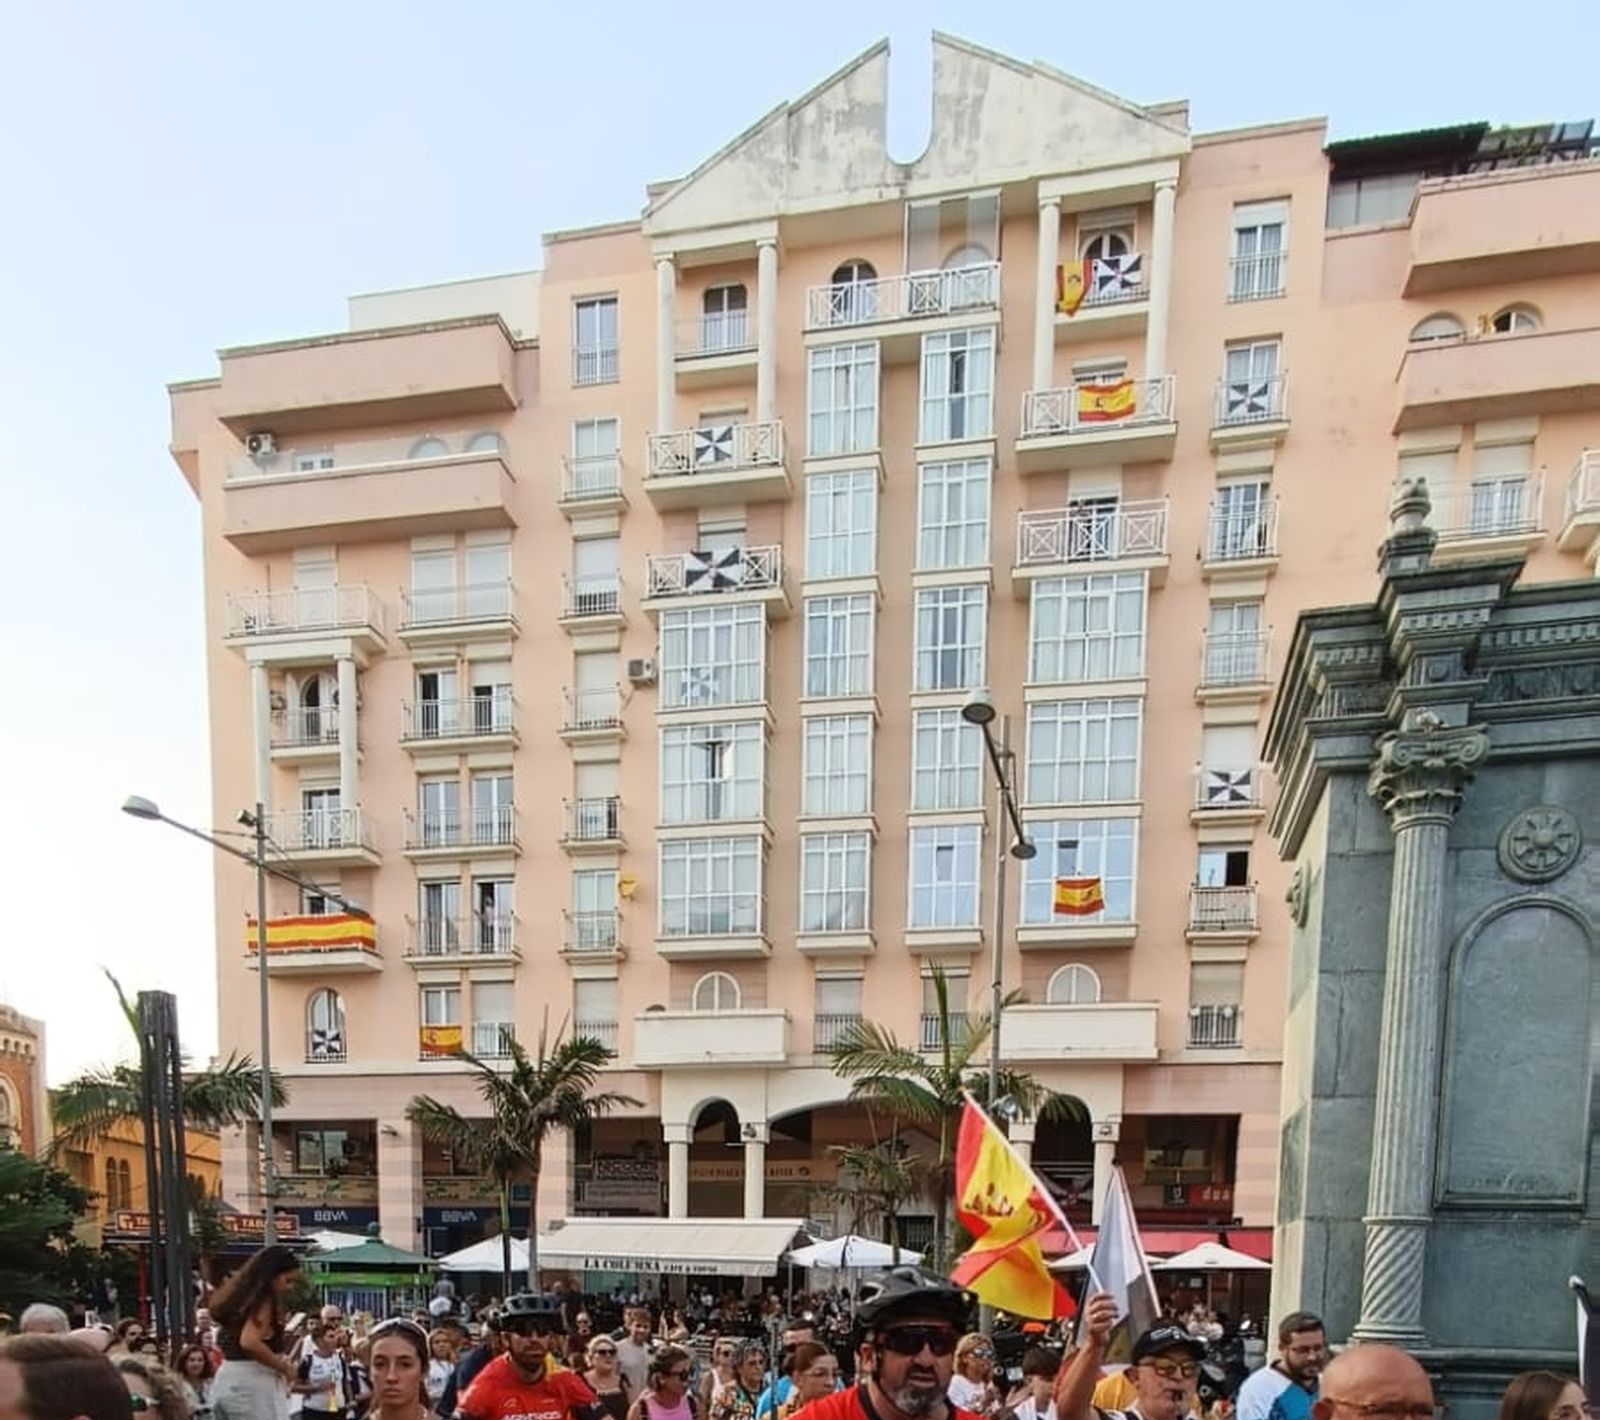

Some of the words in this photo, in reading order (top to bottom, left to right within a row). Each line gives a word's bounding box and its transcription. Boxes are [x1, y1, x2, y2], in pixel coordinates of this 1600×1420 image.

[313, 1210, 349, 1222] BBVA
[441, 1210, 478, 1223] BBVA
[240, 1217, 292, 1230] TABAOS
